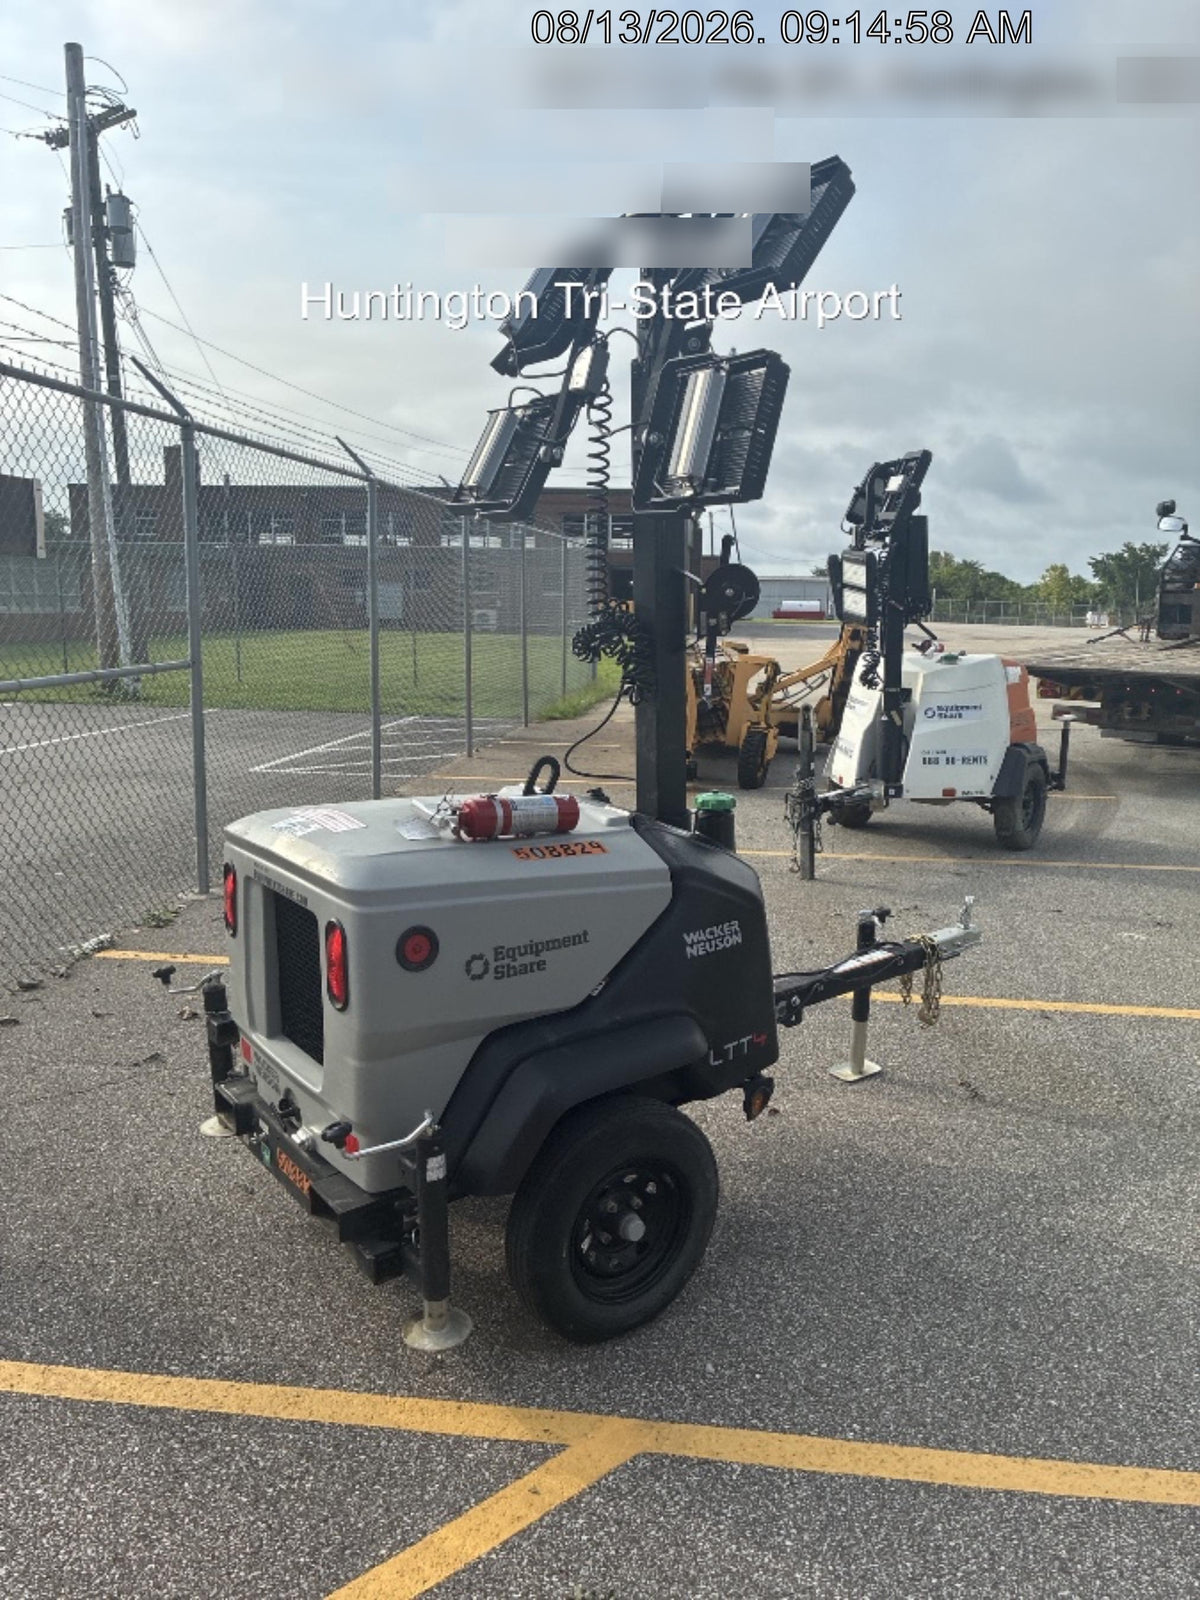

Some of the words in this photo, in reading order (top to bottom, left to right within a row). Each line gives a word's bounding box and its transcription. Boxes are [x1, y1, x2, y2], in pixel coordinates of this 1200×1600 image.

[513, 840, 606, 859] 508829
[683, 920, 741, 945] WACKER
[493, 929, 590, 963] Equipment
[686, 931, 742, 960] NEUSON
[493, 959, 547, 981] Share
